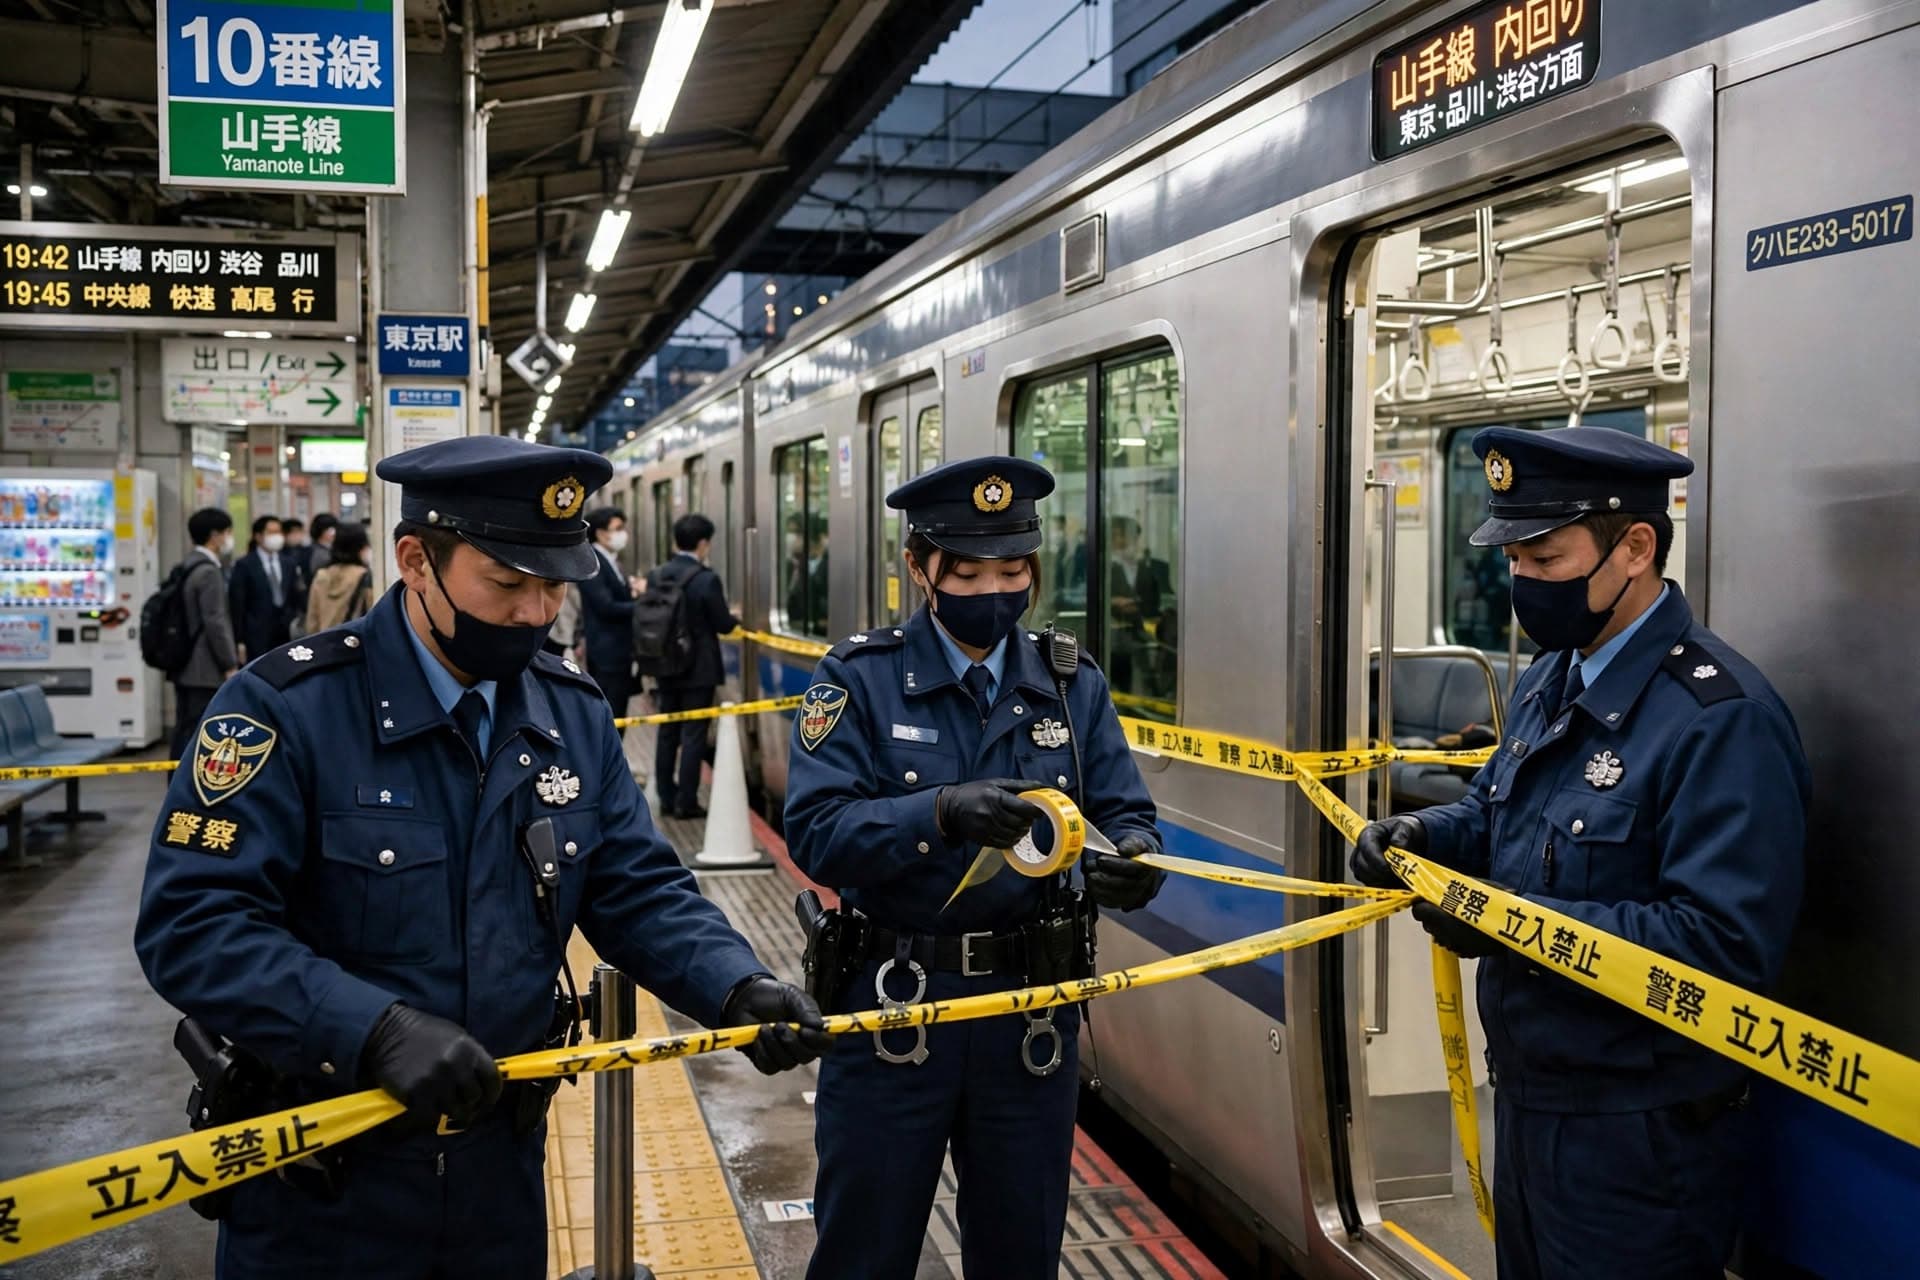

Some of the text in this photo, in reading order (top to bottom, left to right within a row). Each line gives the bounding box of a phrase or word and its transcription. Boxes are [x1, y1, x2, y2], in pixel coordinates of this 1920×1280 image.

[181, 16, 382, 90] 10番線
[1391, 0, 1584, 111] 山手線 内回り
[1399, 41, 1584, 145] 東京・品川・渋谷方面
[221, 112, 342, 155] 山手線
[221, 154, 344, 176] Yamanote Line
[1750, 203, 1907, 263] クハE233-5017
[3, 243, 319, 278] 19:42 山手線 内回り 渋谷 品川
[3, 280, 71, 307] 19:45
[84, 282, 151, 309] 中央線
[169, 283, 216, 311] 快速
[292, 288, 315, 314] 行
[193, 346, 249, 371] 出口
[383, 324, 464, 352] 東京駅
[1162, 732, 1204, 758] 立入禁止
[166, 811, 238, 851] 警察
[1440, 879, 1490, 925] 警察
[1497, 906, 1602, 980] 立入禁止
[1645, 964, 1707, 1028] 警察
[1725, 1003, 1871, 1107] 立入禁止
[87, 1114, 325, 1221] 立入禁止
